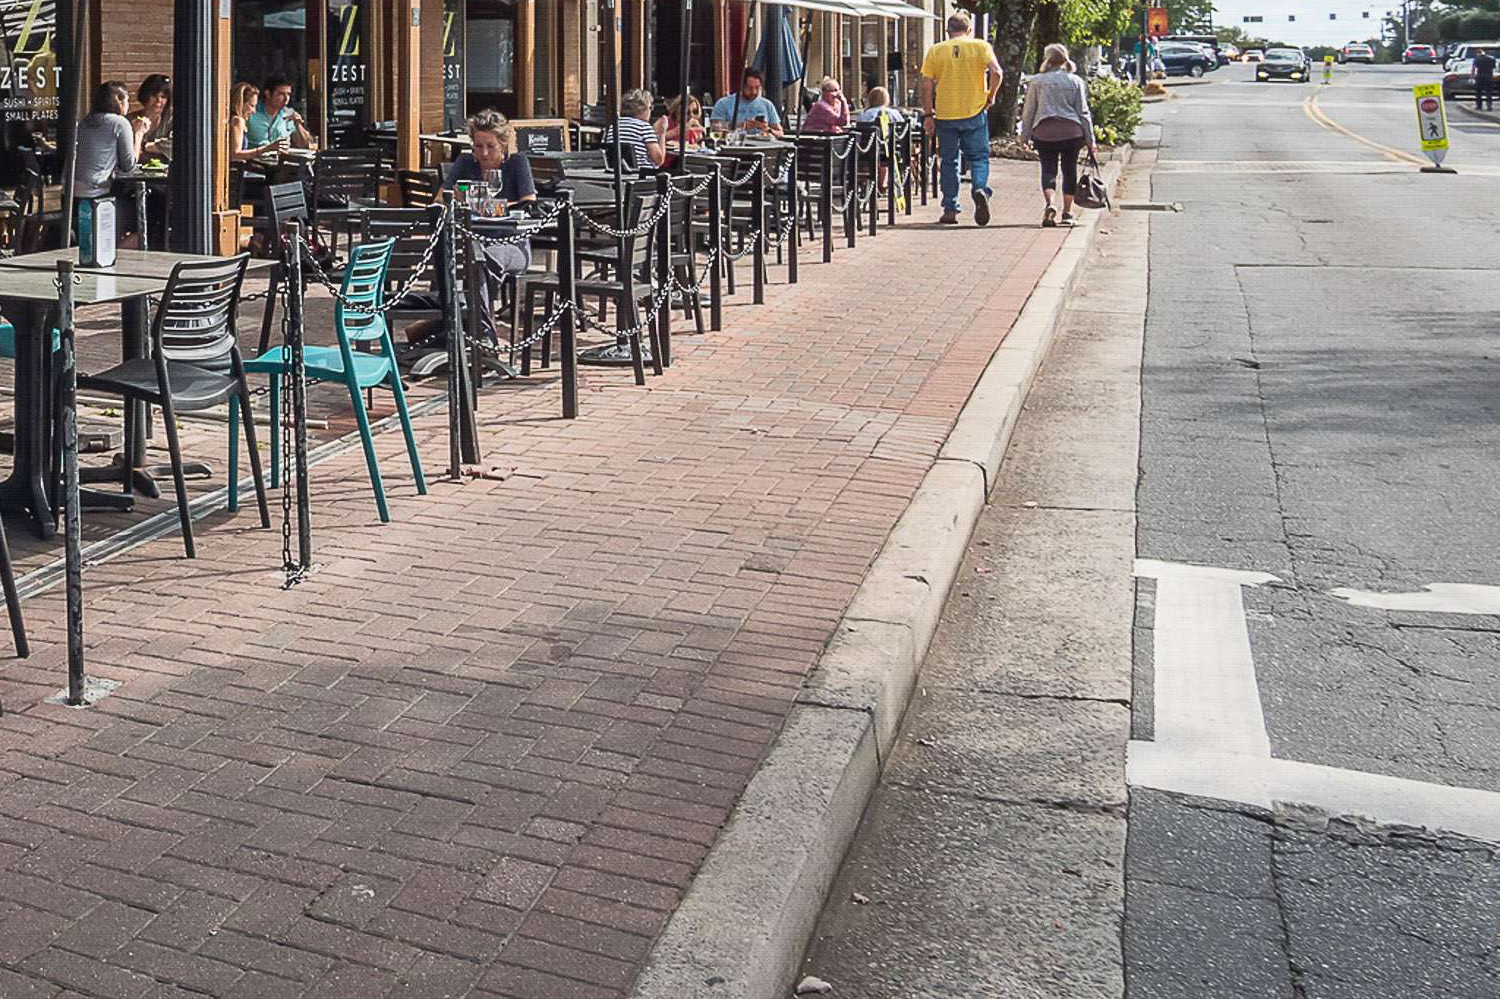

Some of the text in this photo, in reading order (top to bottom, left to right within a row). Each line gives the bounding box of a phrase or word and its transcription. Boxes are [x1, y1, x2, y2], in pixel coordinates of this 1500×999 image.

[0, 66, 63, 89] ZEST
[331, 64, 366, 82] ZEST
[3, 96, 61, 108] SUSHI SPIRITS
[5, 109, 59, 122] SMALL PLATES
